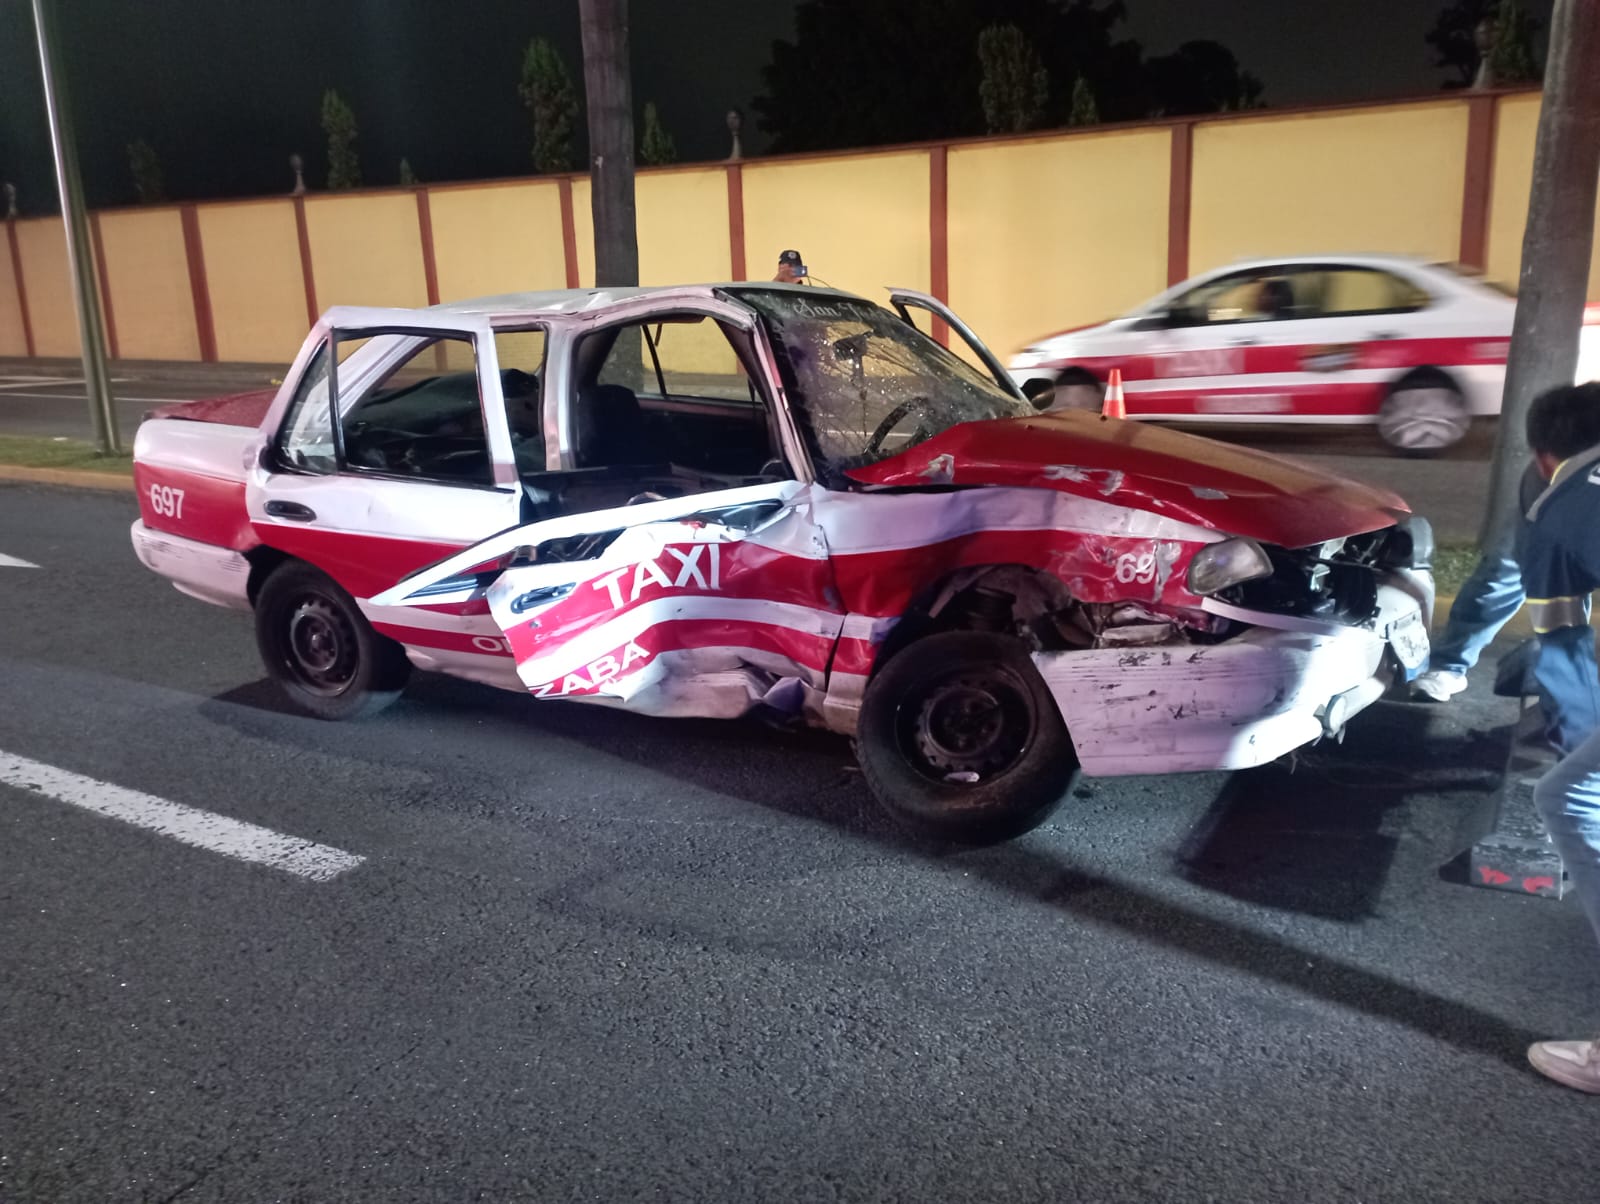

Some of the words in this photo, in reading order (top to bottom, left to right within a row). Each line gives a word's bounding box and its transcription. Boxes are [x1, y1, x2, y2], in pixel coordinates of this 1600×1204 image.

[150, 483, 184, 519] 697
[592, 543, 721, 611] TAXI
[1116, 553, 1166, 585] 69
